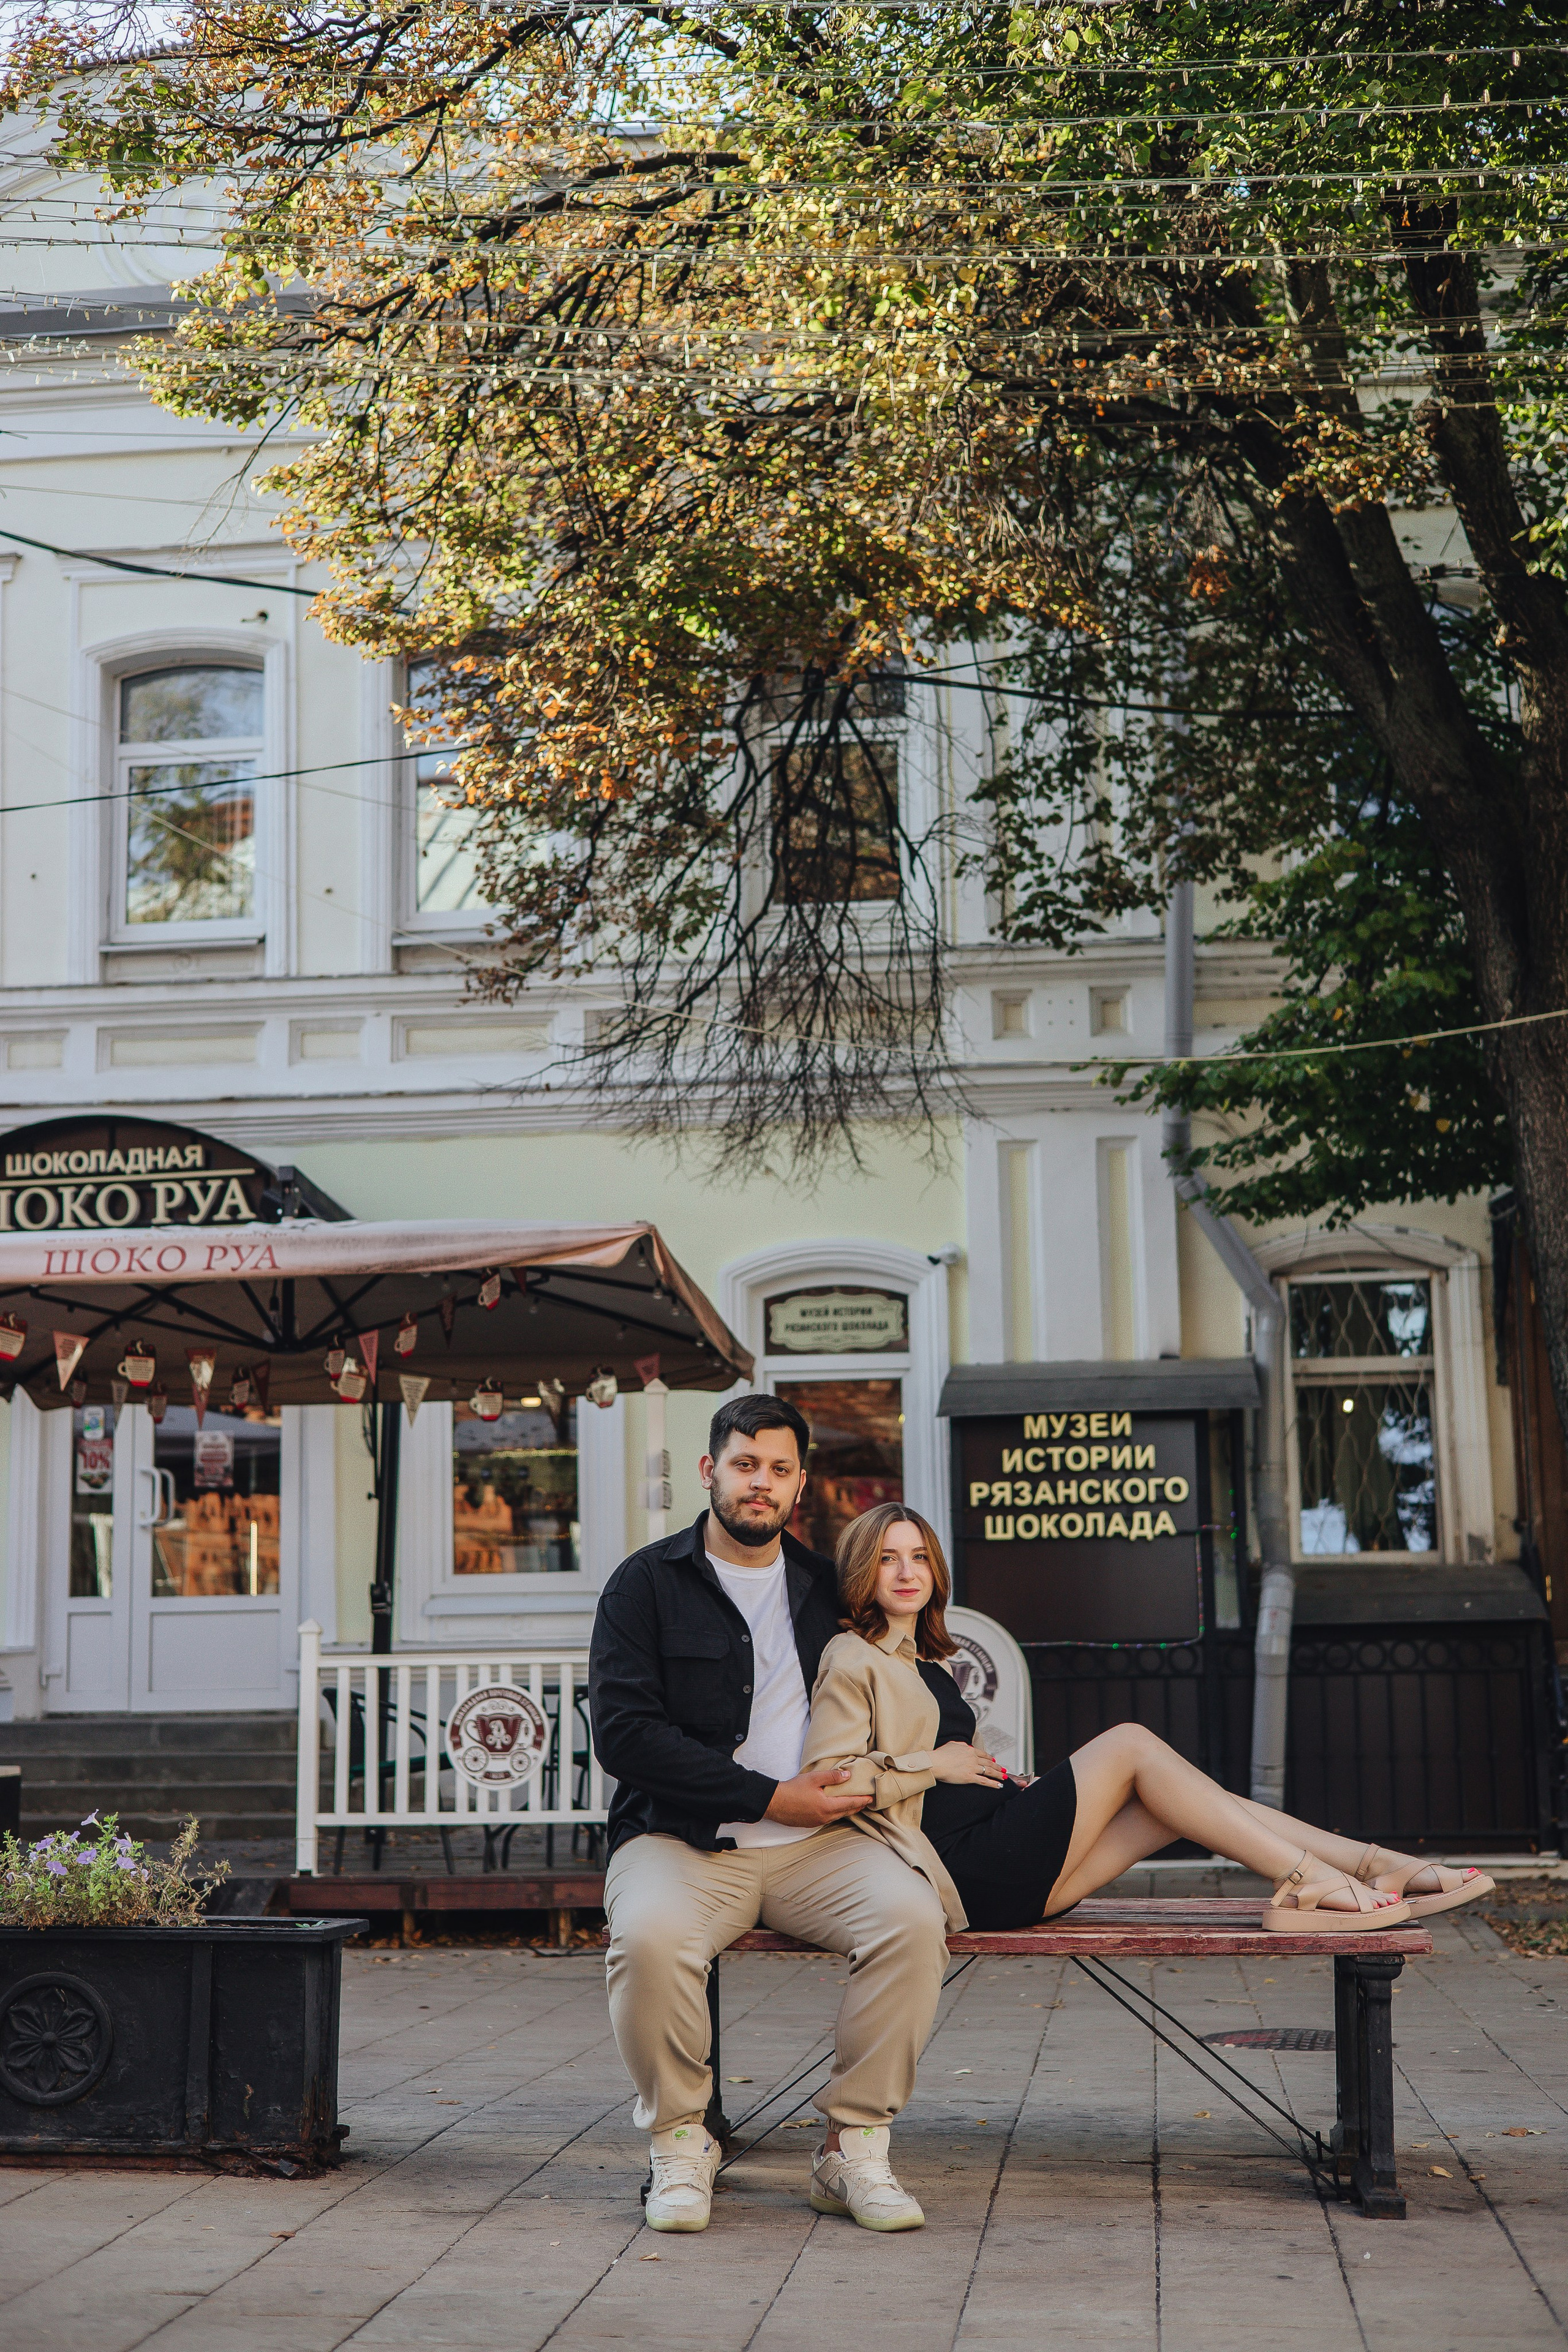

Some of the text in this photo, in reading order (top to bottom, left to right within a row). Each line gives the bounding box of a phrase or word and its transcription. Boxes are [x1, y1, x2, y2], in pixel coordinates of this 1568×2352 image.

[6, 1144, 203, 1178] ШОКОЛАДНАЯ
[150, 1177, 257, 1224] РУА
[42, 1244, 281, 1276] ШОКО РУА
[1001, 1444, 1156, 1474] ИСТОРИИ
[970, 1476, 1189, 1507] РЯЗАНСКОГО
[984, 1510, 1177, 1542] ШОКОЛАДА
